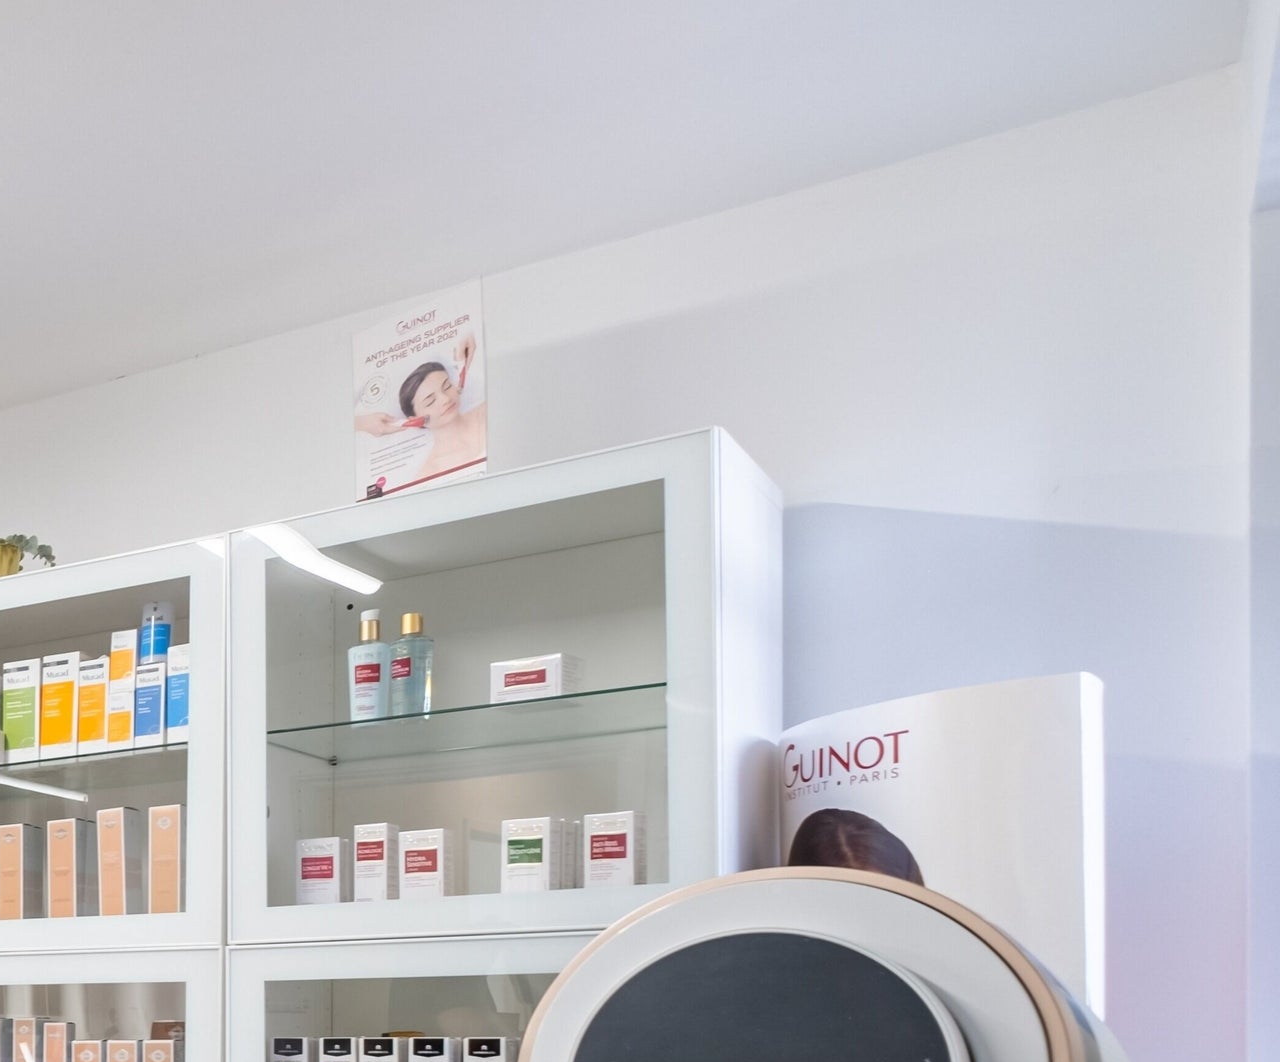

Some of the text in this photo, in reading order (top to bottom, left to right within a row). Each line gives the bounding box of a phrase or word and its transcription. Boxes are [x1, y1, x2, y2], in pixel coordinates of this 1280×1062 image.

[365, 314, 470, 364] ANTI-AGEING SUPPLIER
[396, 309, 437, 333] GUINOT
[376, 329, 458, 368] OF THE YEAR 2021
[783, 729, 910, 788] GUINOT
[849, 767, 900, 786] PARIS
